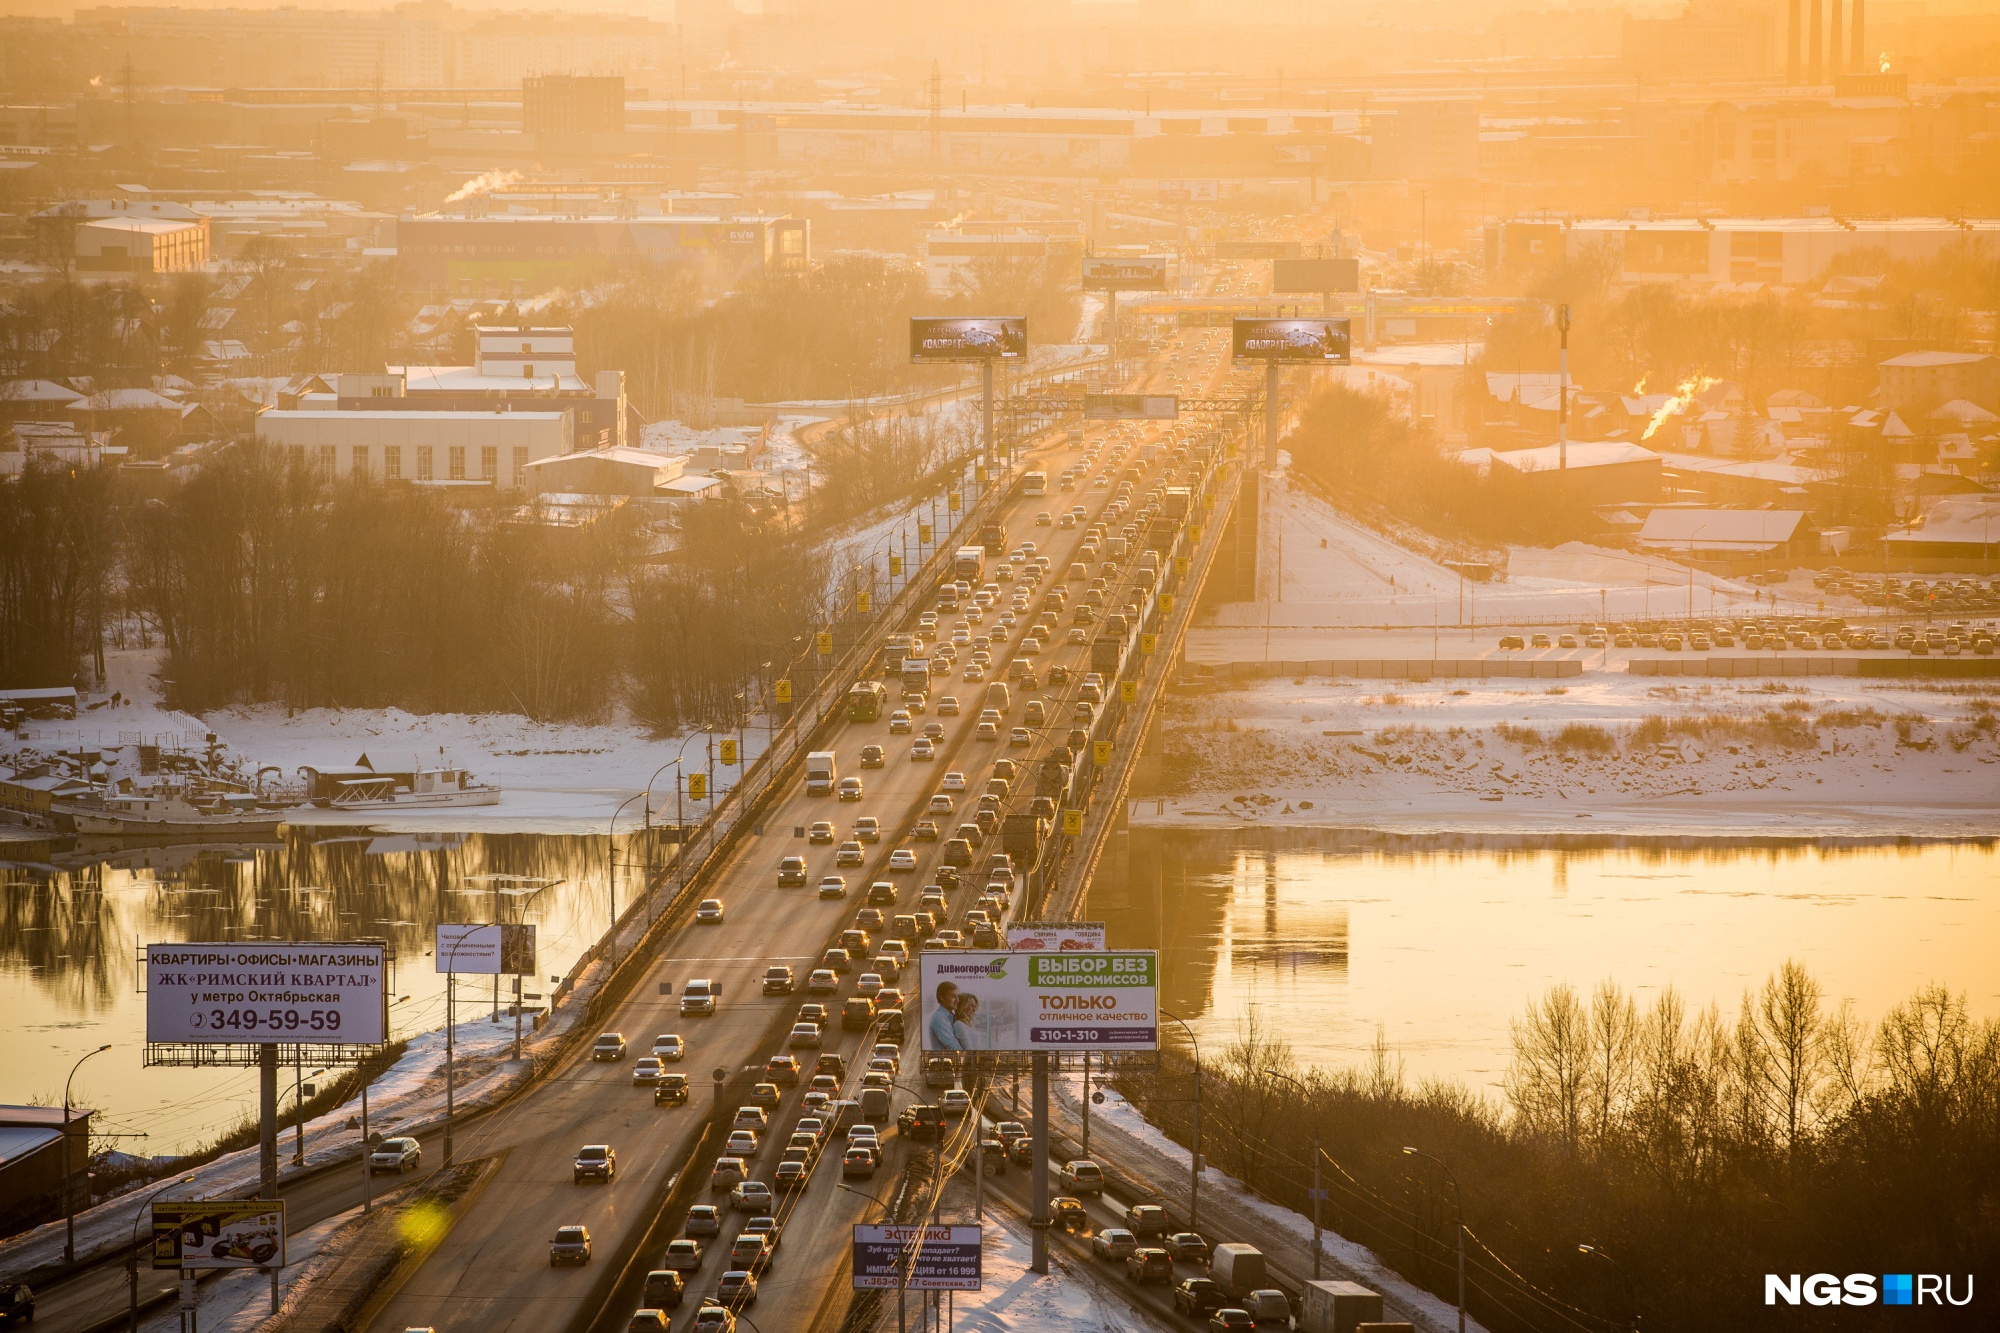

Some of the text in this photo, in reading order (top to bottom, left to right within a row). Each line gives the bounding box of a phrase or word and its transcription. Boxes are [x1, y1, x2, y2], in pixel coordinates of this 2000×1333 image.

[936, 961, 1002, 976] Дивногорский
[1038, 958, 1148, 973] ВЫБОР БЕЗ
[290, 973, 378, 987] КВАРТАЛ»
[1038, 975, 1148, 986] КОМПРОМИССОВ
[190, 990, 341, 1005] у метро Октябрьская
[1039, 995, 1117, 1010] ТОЛЬКО
[210, 1009, 342, 1031] 349-59-59
[1039, 1012, 1148, 1021] отличное качество
[1039, 1030, 1099, 1041] 310-1-310
[867, 1245, 882, 1253] Зуб
[948, 1267, 959, 1275] 16
[960, 1267, 976, 1276] 999
[966, 1280, 978, 1288] 37
